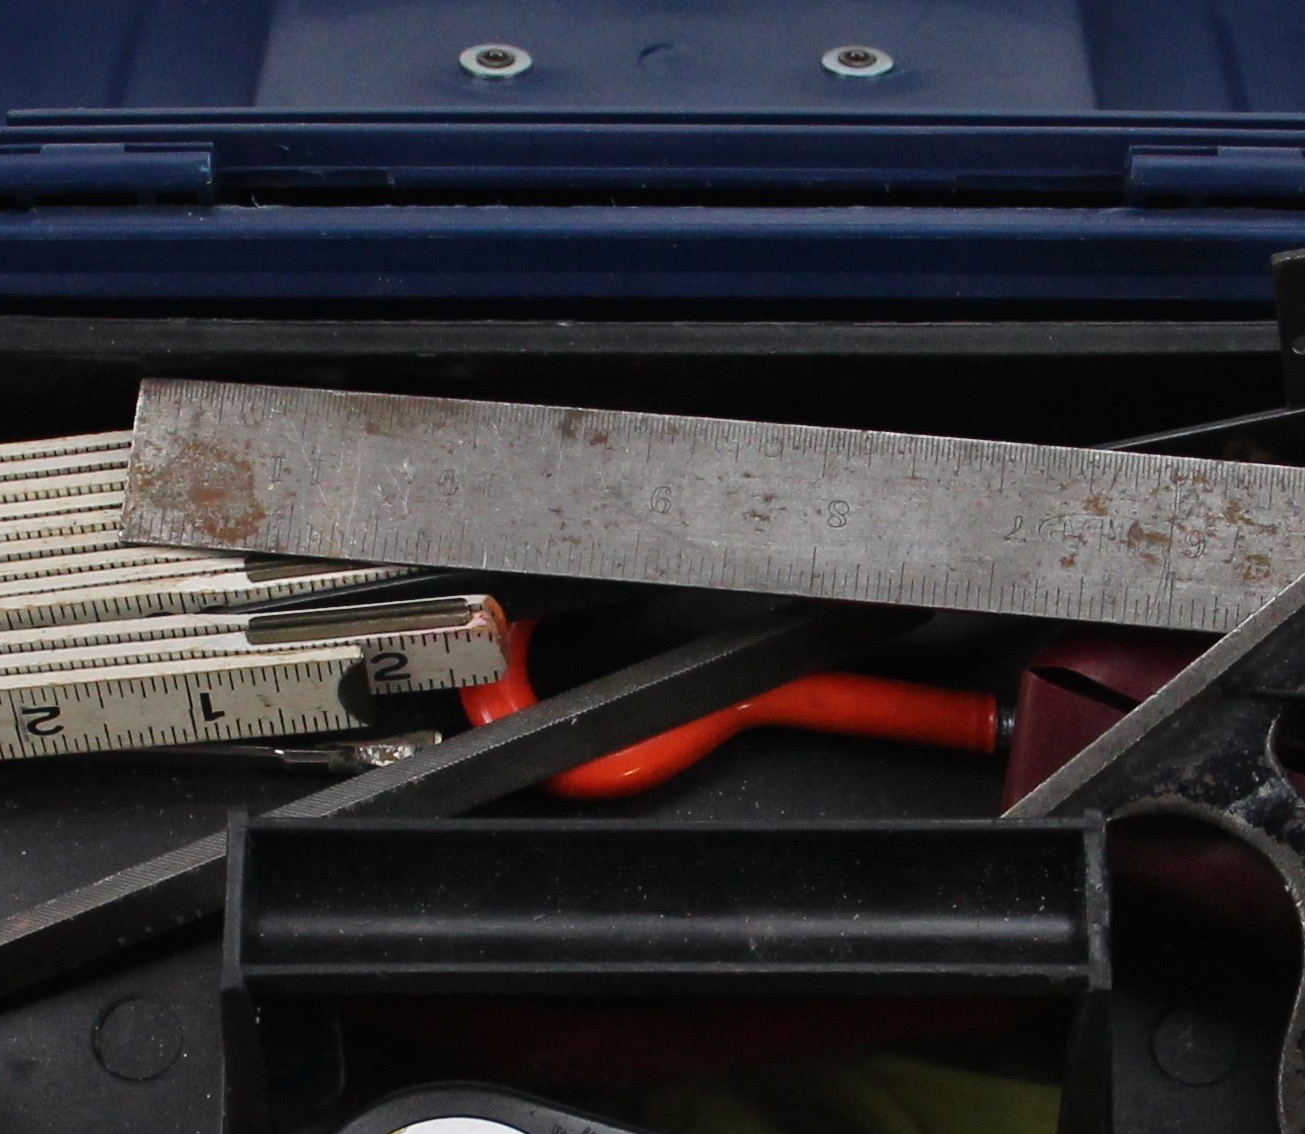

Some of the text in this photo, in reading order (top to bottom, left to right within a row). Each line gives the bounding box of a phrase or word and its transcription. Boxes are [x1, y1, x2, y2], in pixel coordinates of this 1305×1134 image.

[827, 499, 851, 529] 8
[1003, 514, 1028, 544] 7
[370, 651, 412, 682] 2
[21, 705, 65, 738] 2
[199, 691, 226, 723] 1
